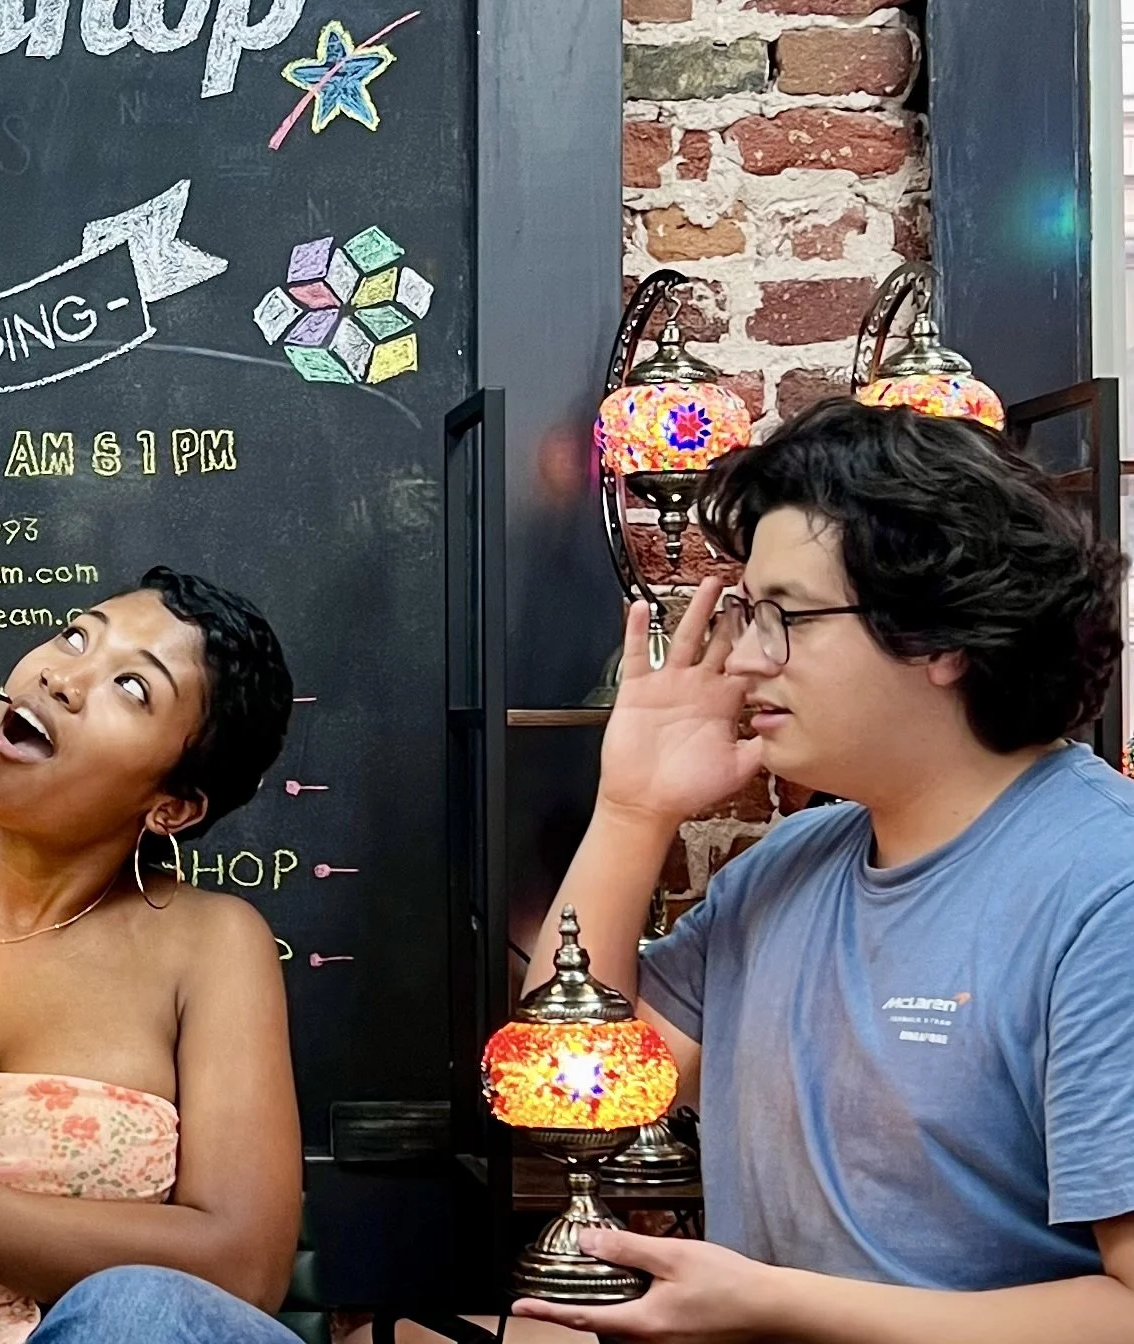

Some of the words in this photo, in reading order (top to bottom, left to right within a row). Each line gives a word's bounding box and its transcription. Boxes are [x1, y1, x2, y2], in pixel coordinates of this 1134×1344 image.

[4, 431, 76, 478] AM
[136, 430, 159, 475] 1
[172, 428, 239, 474] PM
